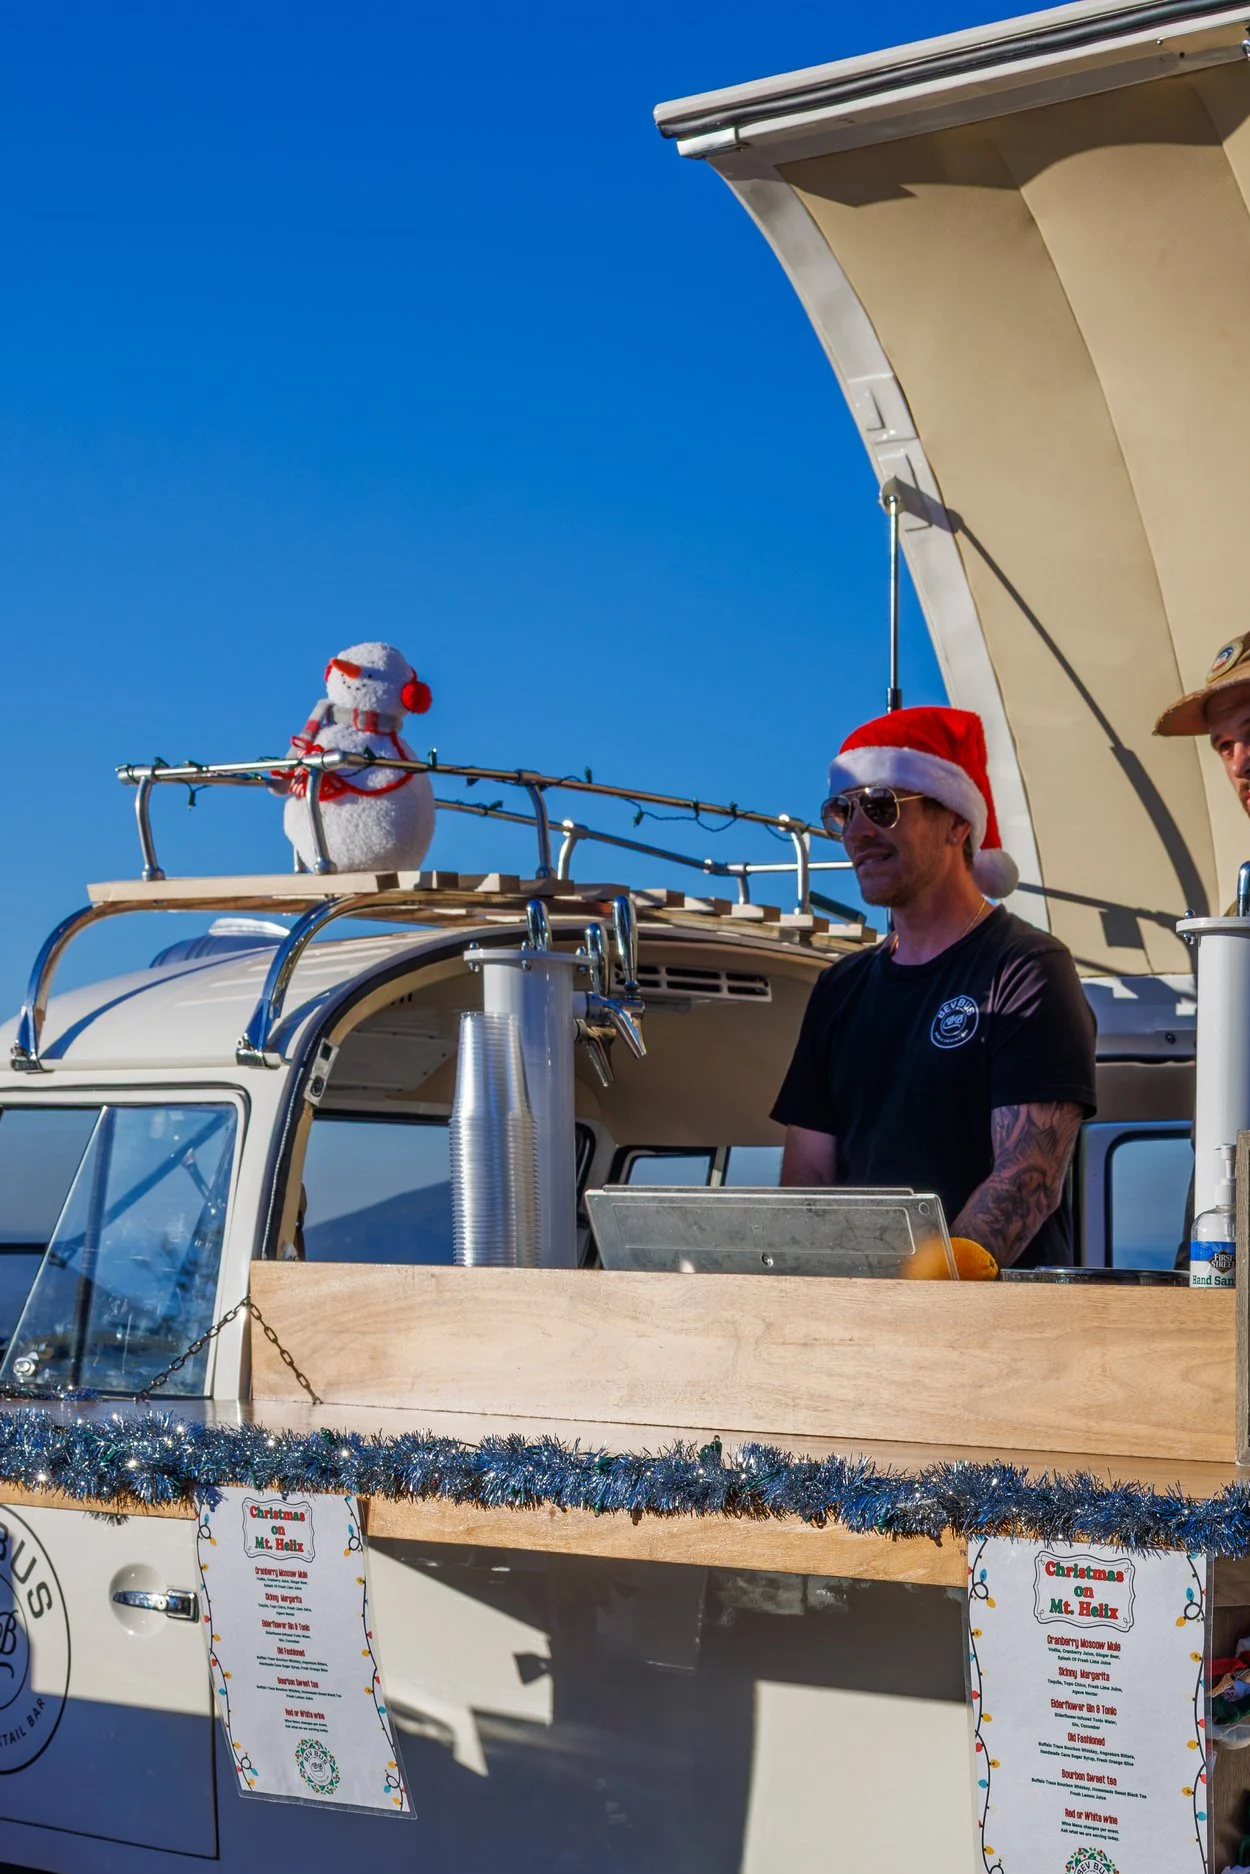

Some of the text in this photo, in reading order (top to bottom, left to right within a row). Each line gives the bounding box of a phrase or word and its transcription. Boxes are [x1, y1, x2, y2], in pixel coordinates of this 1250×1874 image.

[1193, 1276, 1211, 1285] Hand
[250, 1506, 305, 1521] Christmas
[271, 1526, 285, 1535] on
[255, 1537, 304, 1552] Mt. Helix
[1046, 1561, 1124, 1582] Christmas
[1074, 1586, 1094, 1598] on
[1049, 1598, 1118, 1619] Mt. Helix
[1047, 1635, 1121, 1651] Cranberry Moscow Mule
[1059, 1667, 1110, 1681] Skinny Margarita
[27, 1698, 45, 1727] BAR
[1051, 1699, 1085, 1711] Elderflower
[1086, 1703, 1095, 1713] Gin
[1102, 1705, 1117, 1716] Tonic
[1068, 1732, 1105, 1746] Old Fashioned
[1062, 1769, 1117, 1786] Bourbon Sweet tea
[1065, 1808, 1075, 1818] Red
[1085, 1811, 1102, 1822] White
[1103, 1814, 1118, 1825] wine
